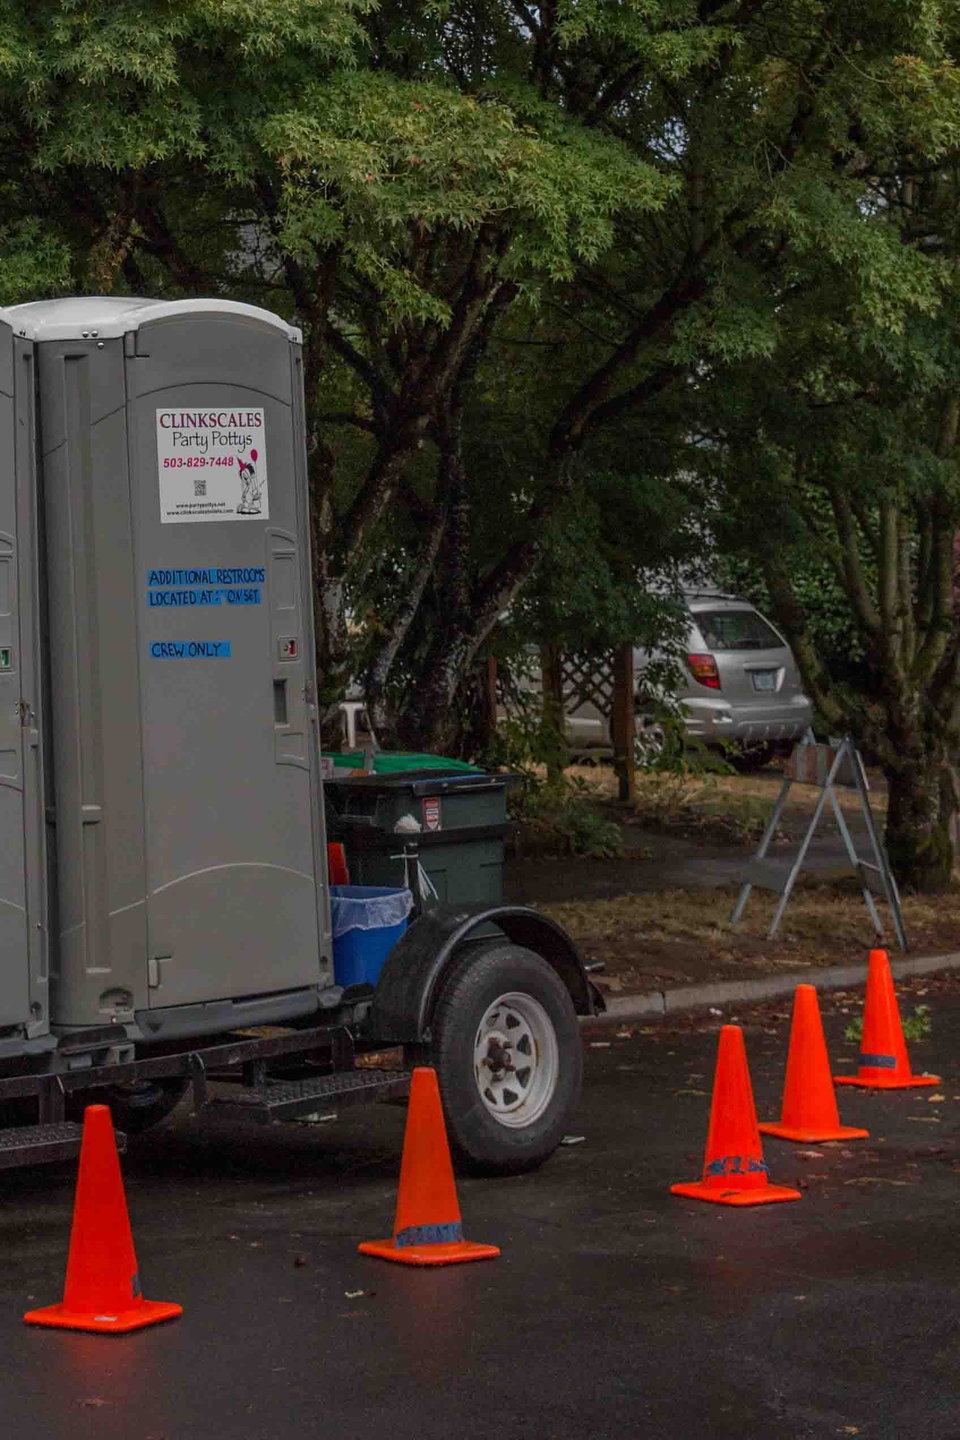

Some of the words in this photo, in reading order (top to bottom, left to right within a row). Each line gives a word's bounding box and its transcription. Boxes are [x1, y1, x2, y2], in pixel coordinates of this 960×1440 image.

[159, 413, 262, 429] CLINKSCALES
[172, 431, 210, 455] Party
[211, 430, 254, 454] Pottys
[163, 456, 235, 468] 503-829-7448
[149, 570, 215, 586] ADDITIONAL
[216, 568, 266, 585] RESTROOMS
[150, 590, 197, 606] LOCATED
[151, 643, 185, 658] CREW
[188, 642, 222, 658] ONLY
